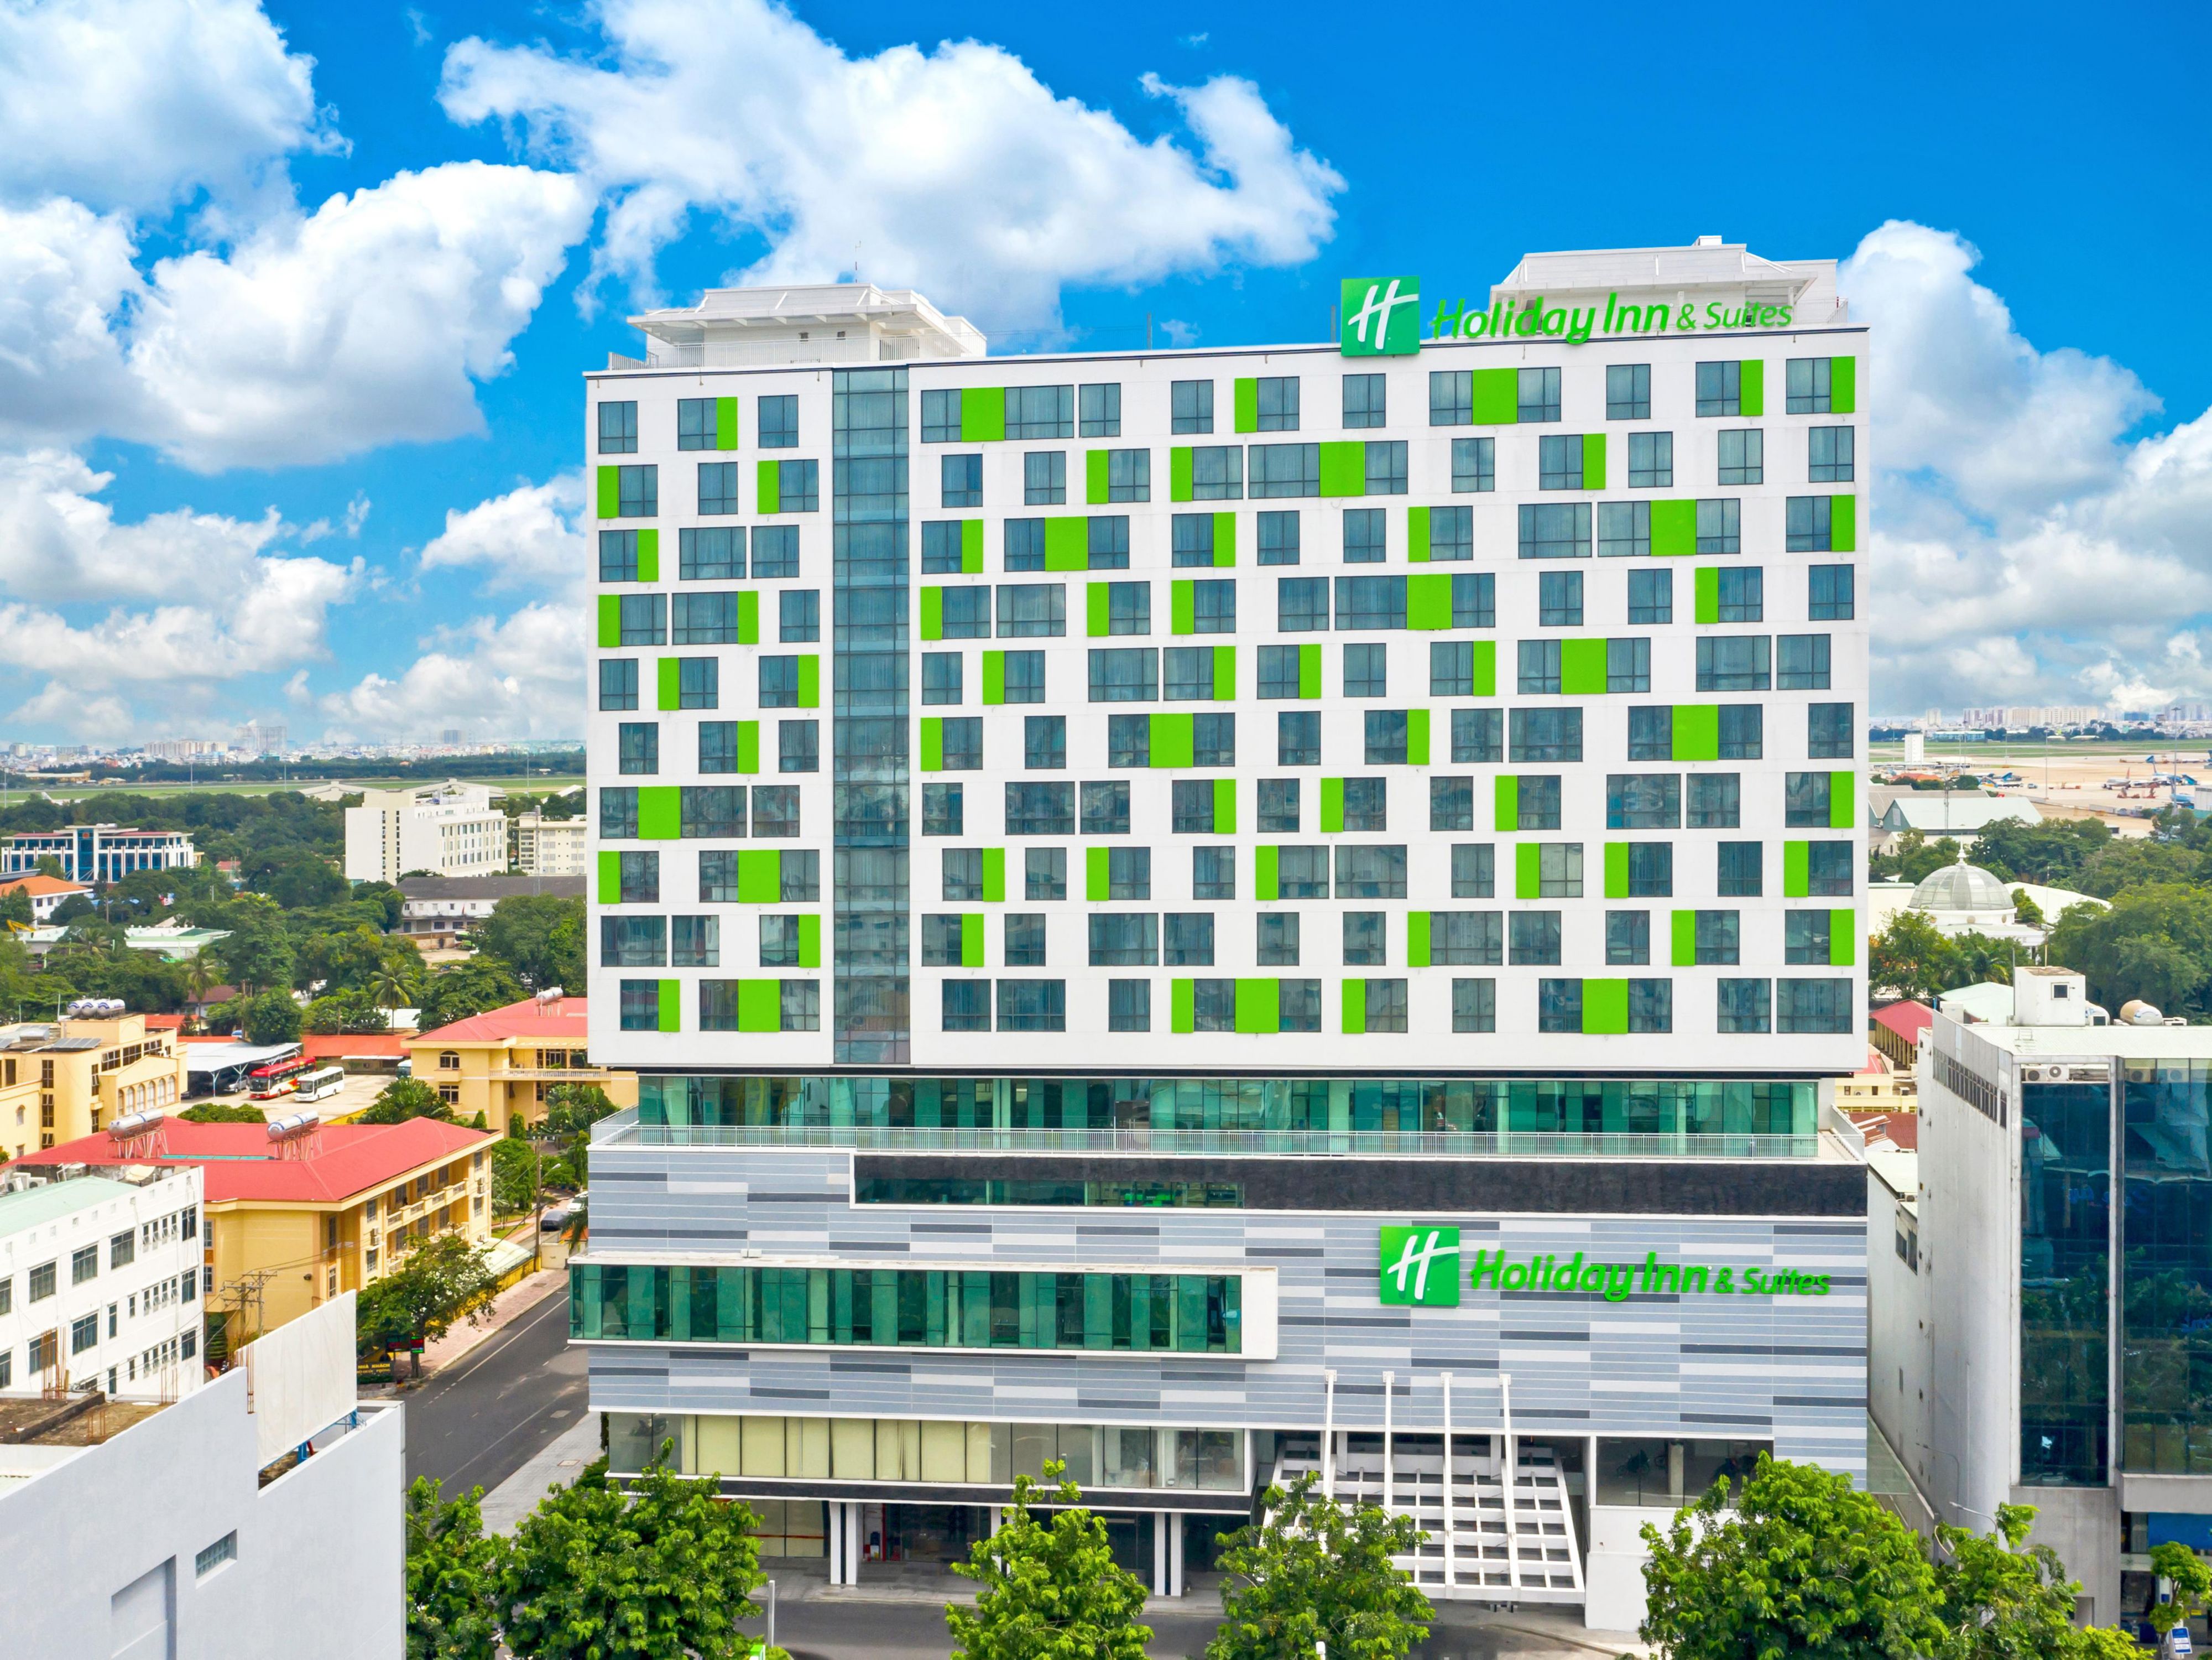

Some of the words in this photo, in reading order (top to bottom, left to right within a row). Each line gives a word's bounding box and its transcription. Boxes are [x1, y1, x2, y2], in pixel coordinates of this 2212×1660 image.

[1430, 295, 1596, 345] Holiday
[1603, 292, 1670, 334] Inn
[1676, 303, 1697, 331] &
[1703, 300, 1793, 330] Suites
[1469, 1249, 1636, 1302] Holiday
[1641, 1251, 1709, 1293] Inn
[1714, 1267, 1735, 1294] &
[1741, 1267, 1832, 1295] Suites
